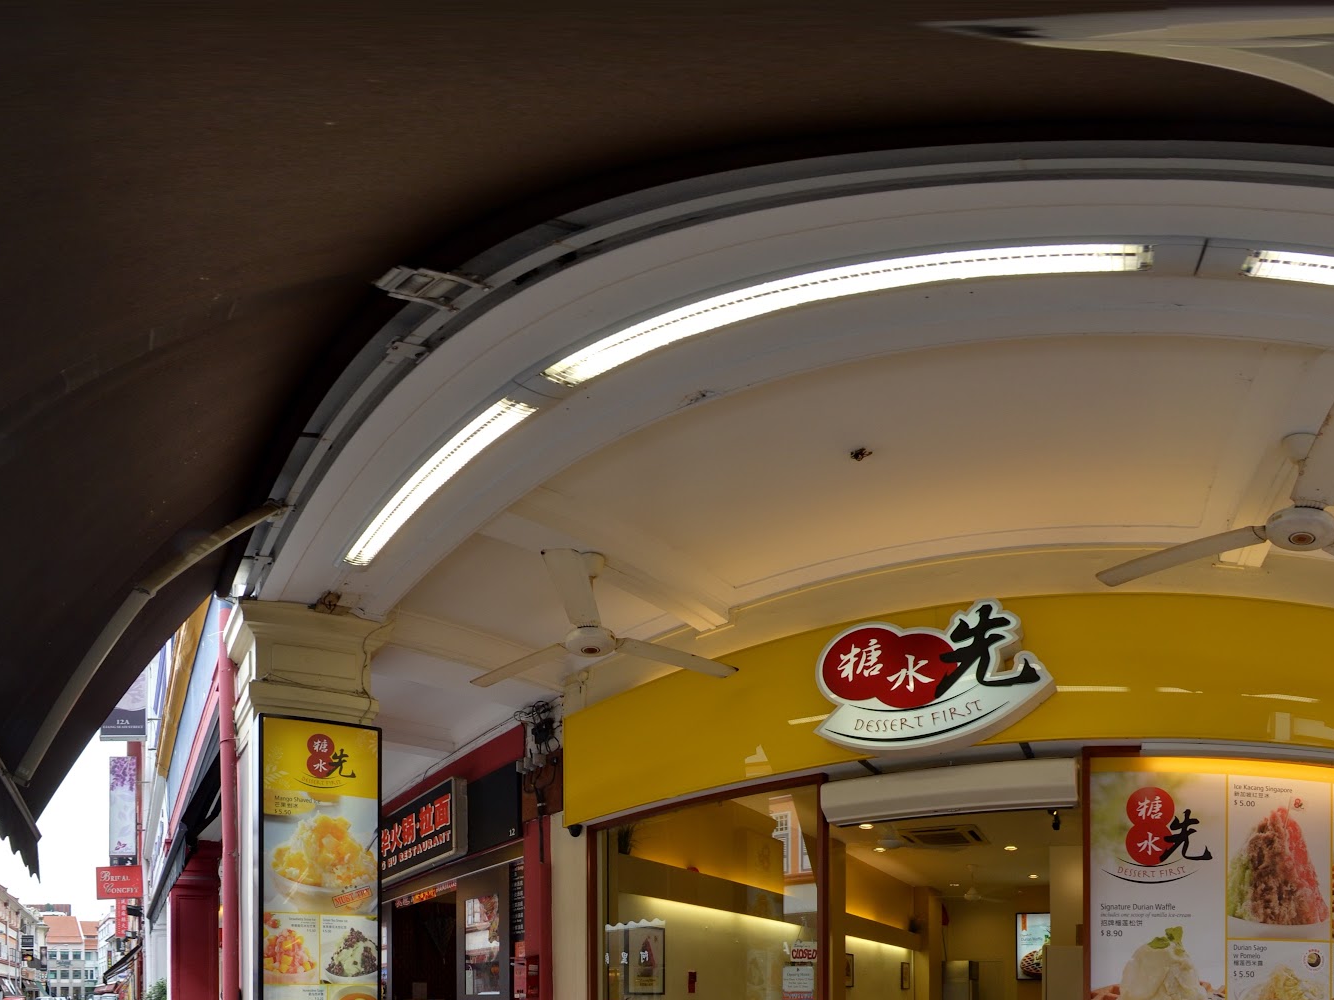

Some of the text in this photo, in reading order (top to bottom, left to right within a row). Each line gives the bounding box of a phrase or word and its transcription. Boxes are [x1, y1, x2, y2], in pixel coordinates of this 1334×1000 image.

[854, 699, 984, 733] DESSERT FIRST
[1243, 784, 1264, 792] Kacang
[1265, 785, 1293, 793] Singapore
[274, 795, 293, 803] Mango
[294, 796, 313, 804] Shaved
[509, 828, 516, 837] 12
[388, 830, 452, 867] HU RESTAURANT
[1117, 866, 1187, 878] DESSERT FIRST
[334, 893, 354, 906] MUST
[1100, 903, 1176, 912] Signature Durian Waffle
[791, 948, 818, 960] CLOSED
